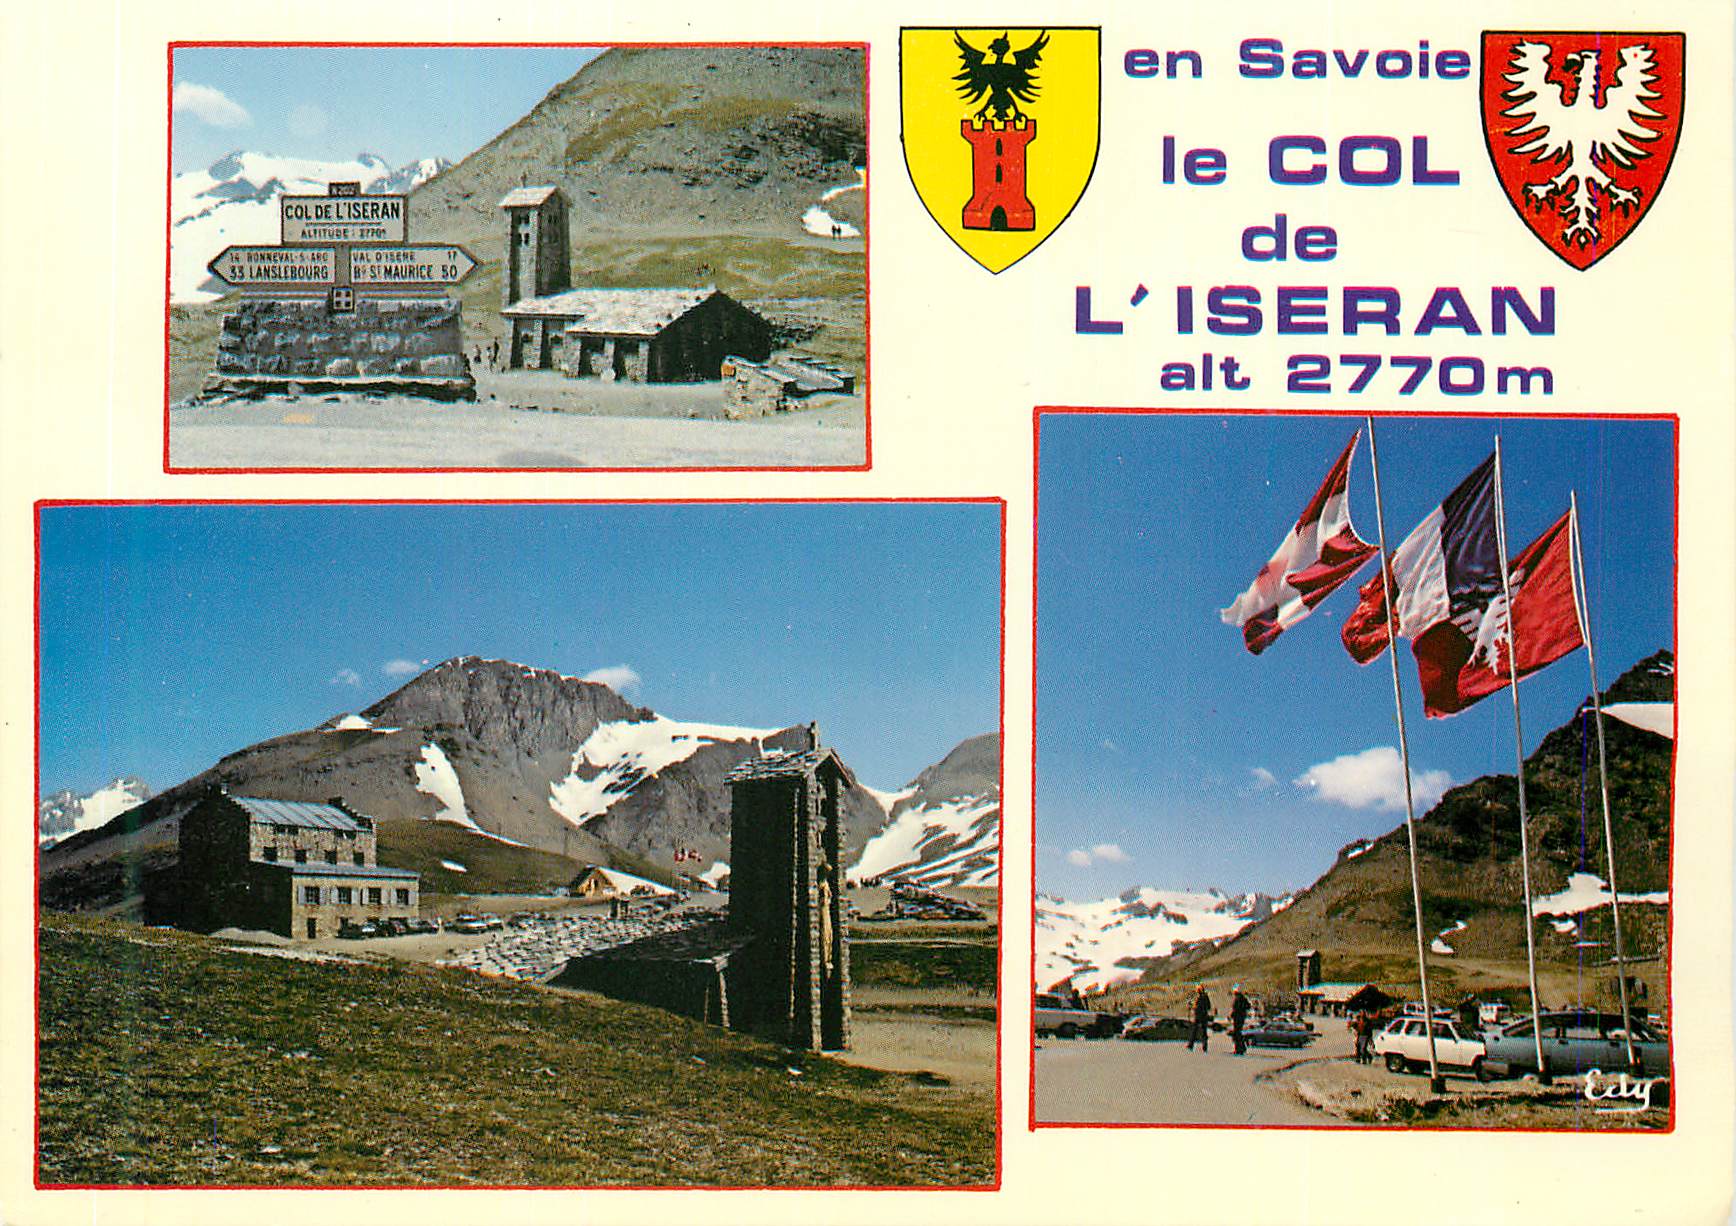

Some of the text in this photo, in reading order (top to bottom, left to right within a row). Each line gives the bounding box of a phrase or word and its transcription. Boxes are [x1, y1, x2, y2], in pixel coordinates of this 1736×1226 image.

[1124, 39, 1471, 79] en Savoie
[1163, 135, 1460, 185] le COL
[285, 202, 400, 219] COL DE L'ISERAN
[1242, 213, 1338, 261] de
[353, 252, 370, 262] VAL
[230, 265, 328, 279] 33 LANSLEBOURG
[384, 264, 433, 279] MAURICE
[441, 264, 458, 279] 50
[1161, 352, 1554, 394] alt 2770m
